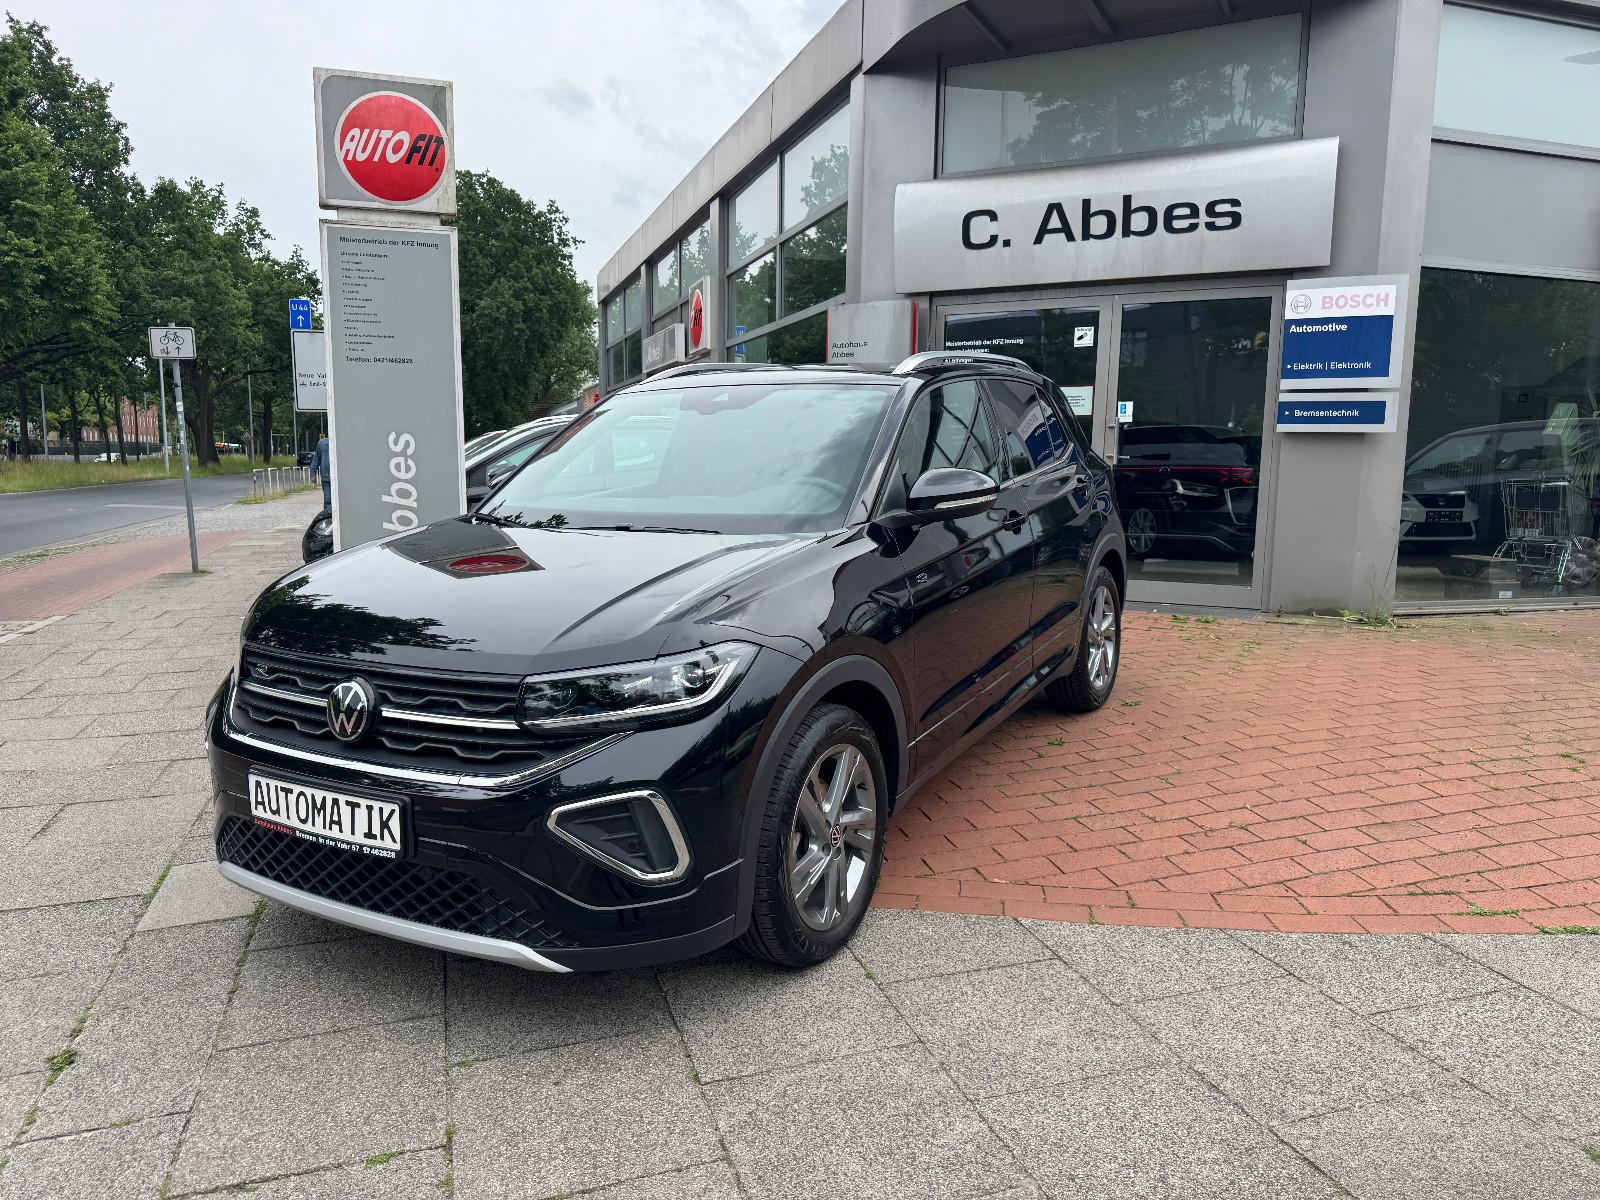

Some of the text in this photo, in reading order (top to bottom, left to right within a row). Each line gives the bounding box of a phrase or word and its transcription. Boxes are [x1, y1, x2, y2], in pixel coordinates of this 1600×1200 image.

[961, 194, 1243, 251] C. Abbes
[339, 236, 387, 246] Meisterbetrieb
[416, 241, 439, 250] Innung
[1321, 292, 1390, 310] BOSCH
[1289, 322, 1348, 334] Automotive
[345, 355, 372, 364] Telefon:
[1293, 362, 1323, 371] Elektrik
[1330, 361, 1372, 370] Elektronik
[1294, 408, 1360, 418] Bremsentechnik
[254, 779, 398, 844] AUTOMATIK
[295, 830, 317, 842] Bremen
[325, 838, 336, 847] der
